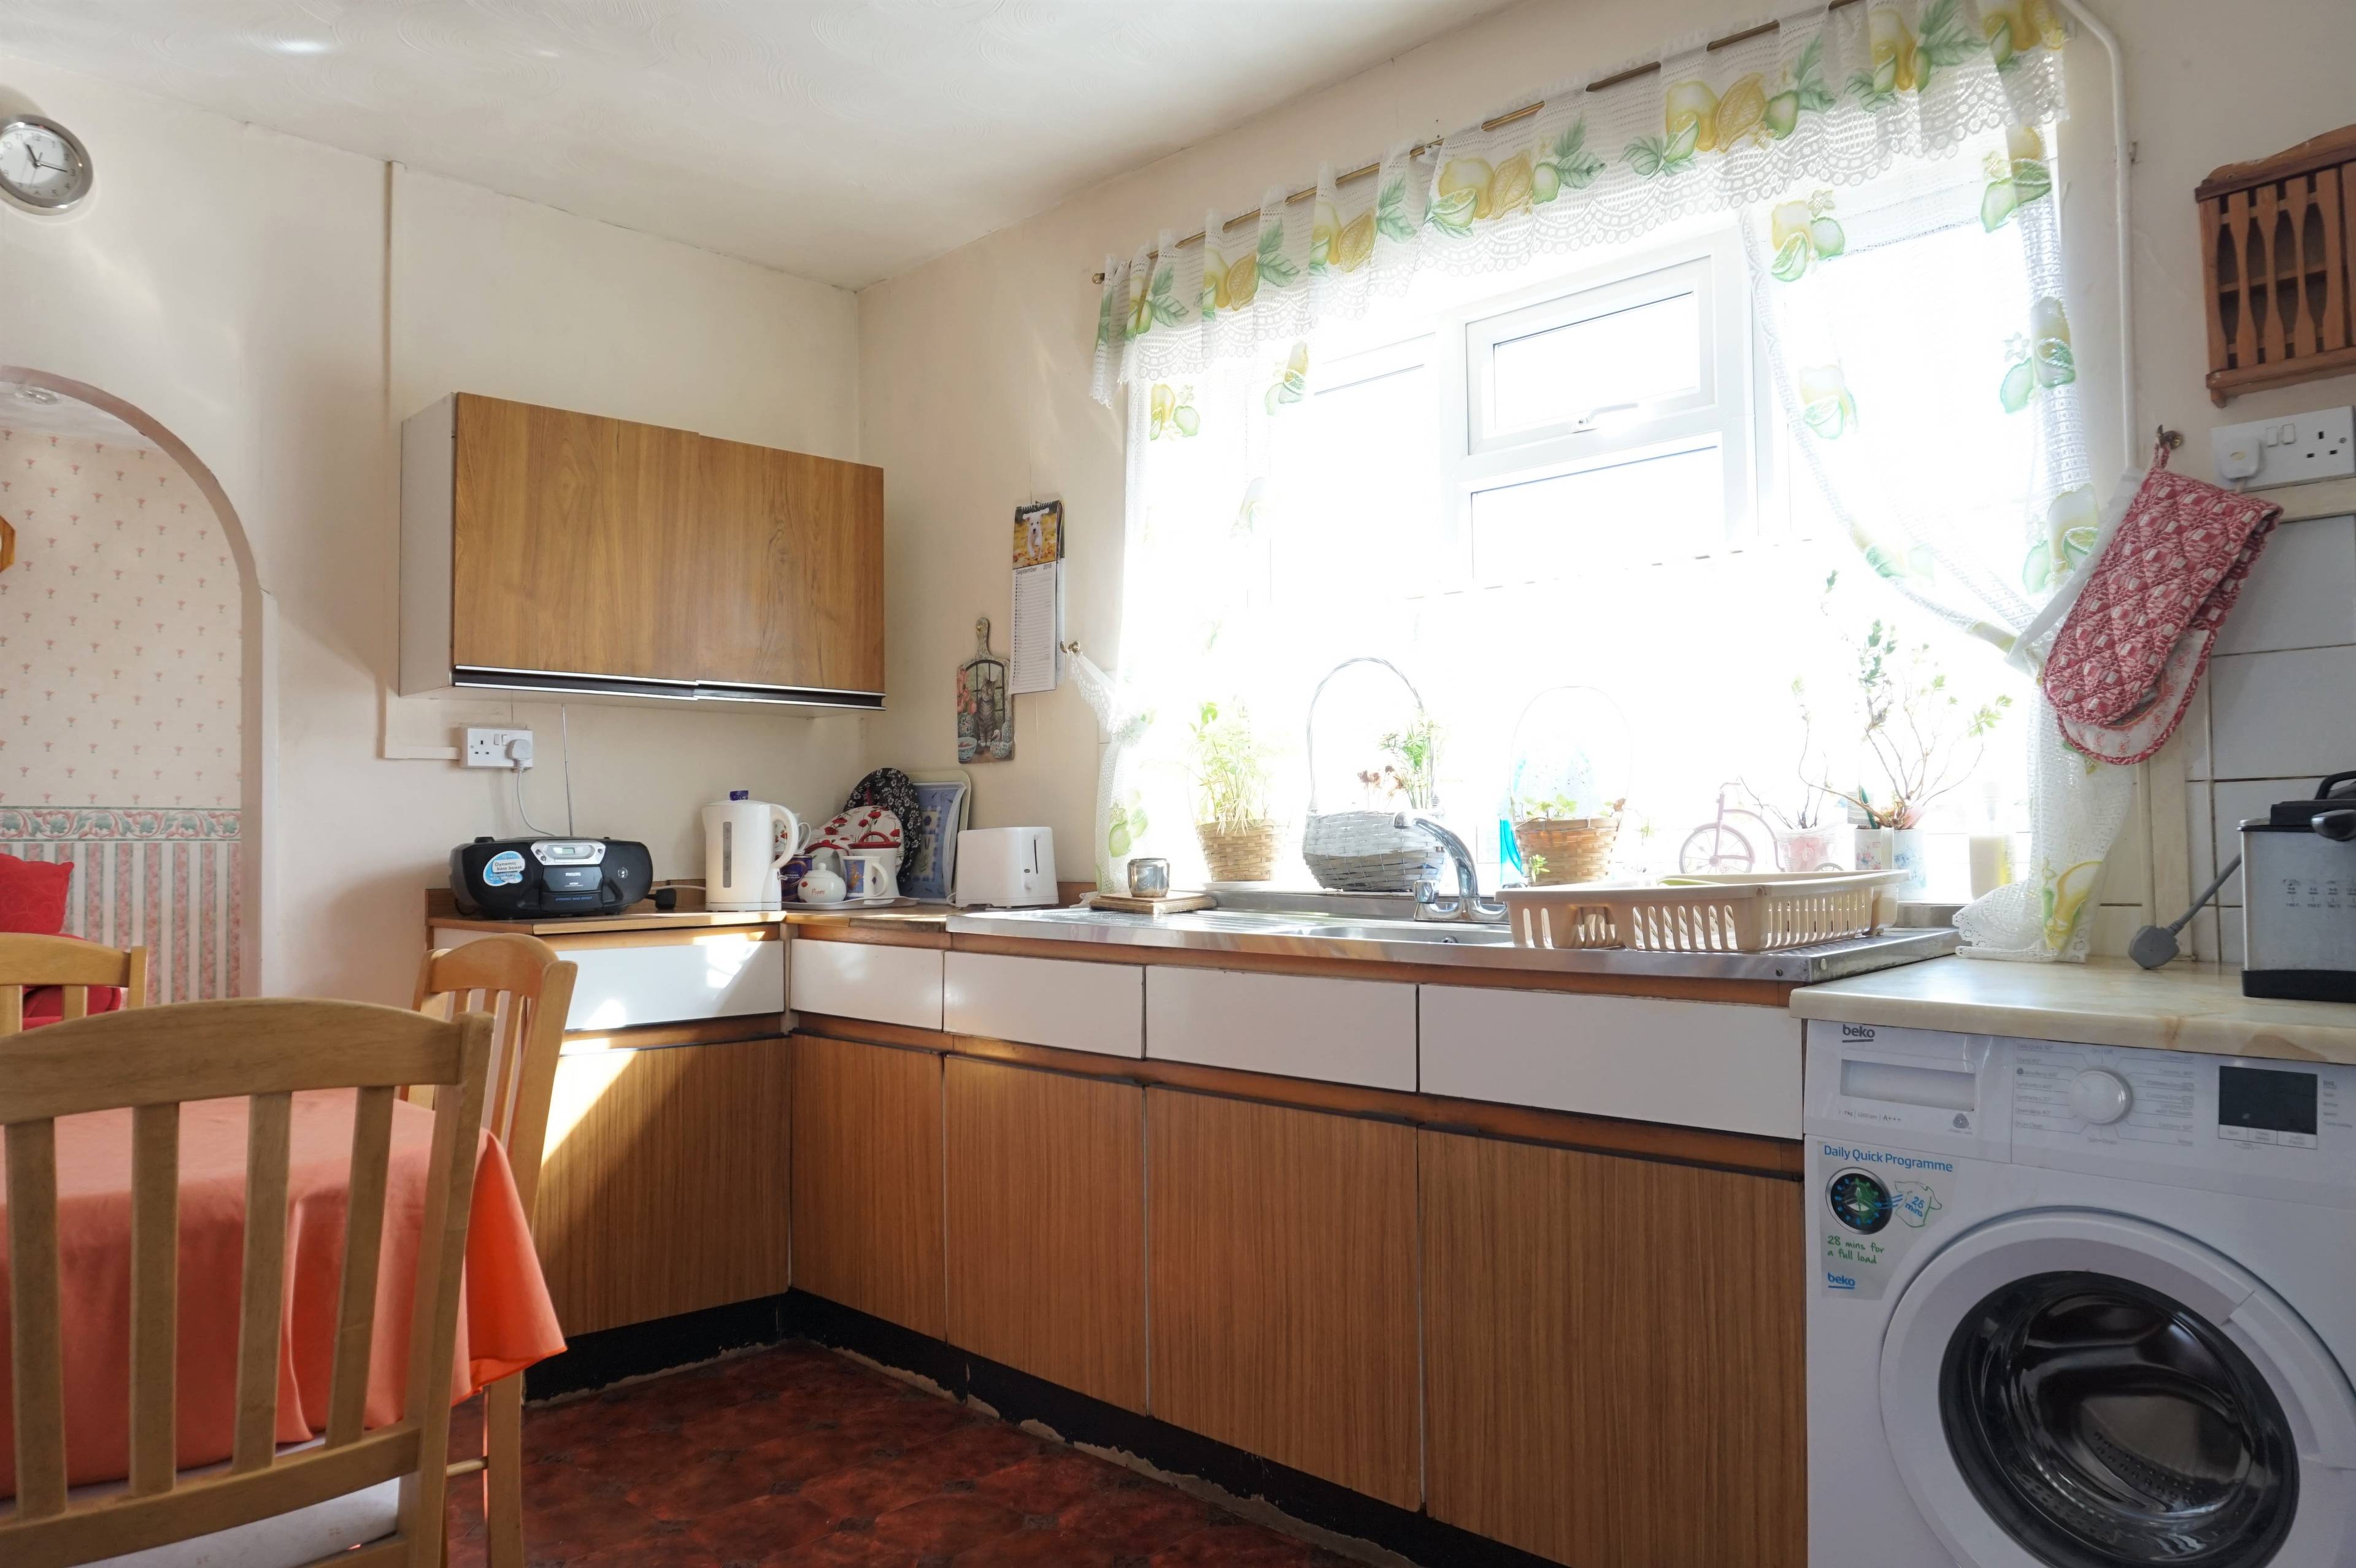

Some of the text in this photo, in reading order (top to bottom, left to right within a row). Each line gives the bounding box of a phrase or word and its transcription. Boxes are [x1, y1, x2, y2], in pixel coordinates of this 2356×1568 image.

[1016, 567, 1037, 575] September
[1842, 1024, 1875, 1039] beko
[1824, 1145, 1954, 1172] Daily Quick Programme
[1905, 1202, 1924, 1217] mins
[1912, 1196, 1925, 1208] 28
[1827, 1236, 1884, 1253] 28 mins for
[1838, 1248, 1853, 1260] full
[1858, 1251, 1877, 1264] load
[1828, 1272, 1855, 1286] beko
